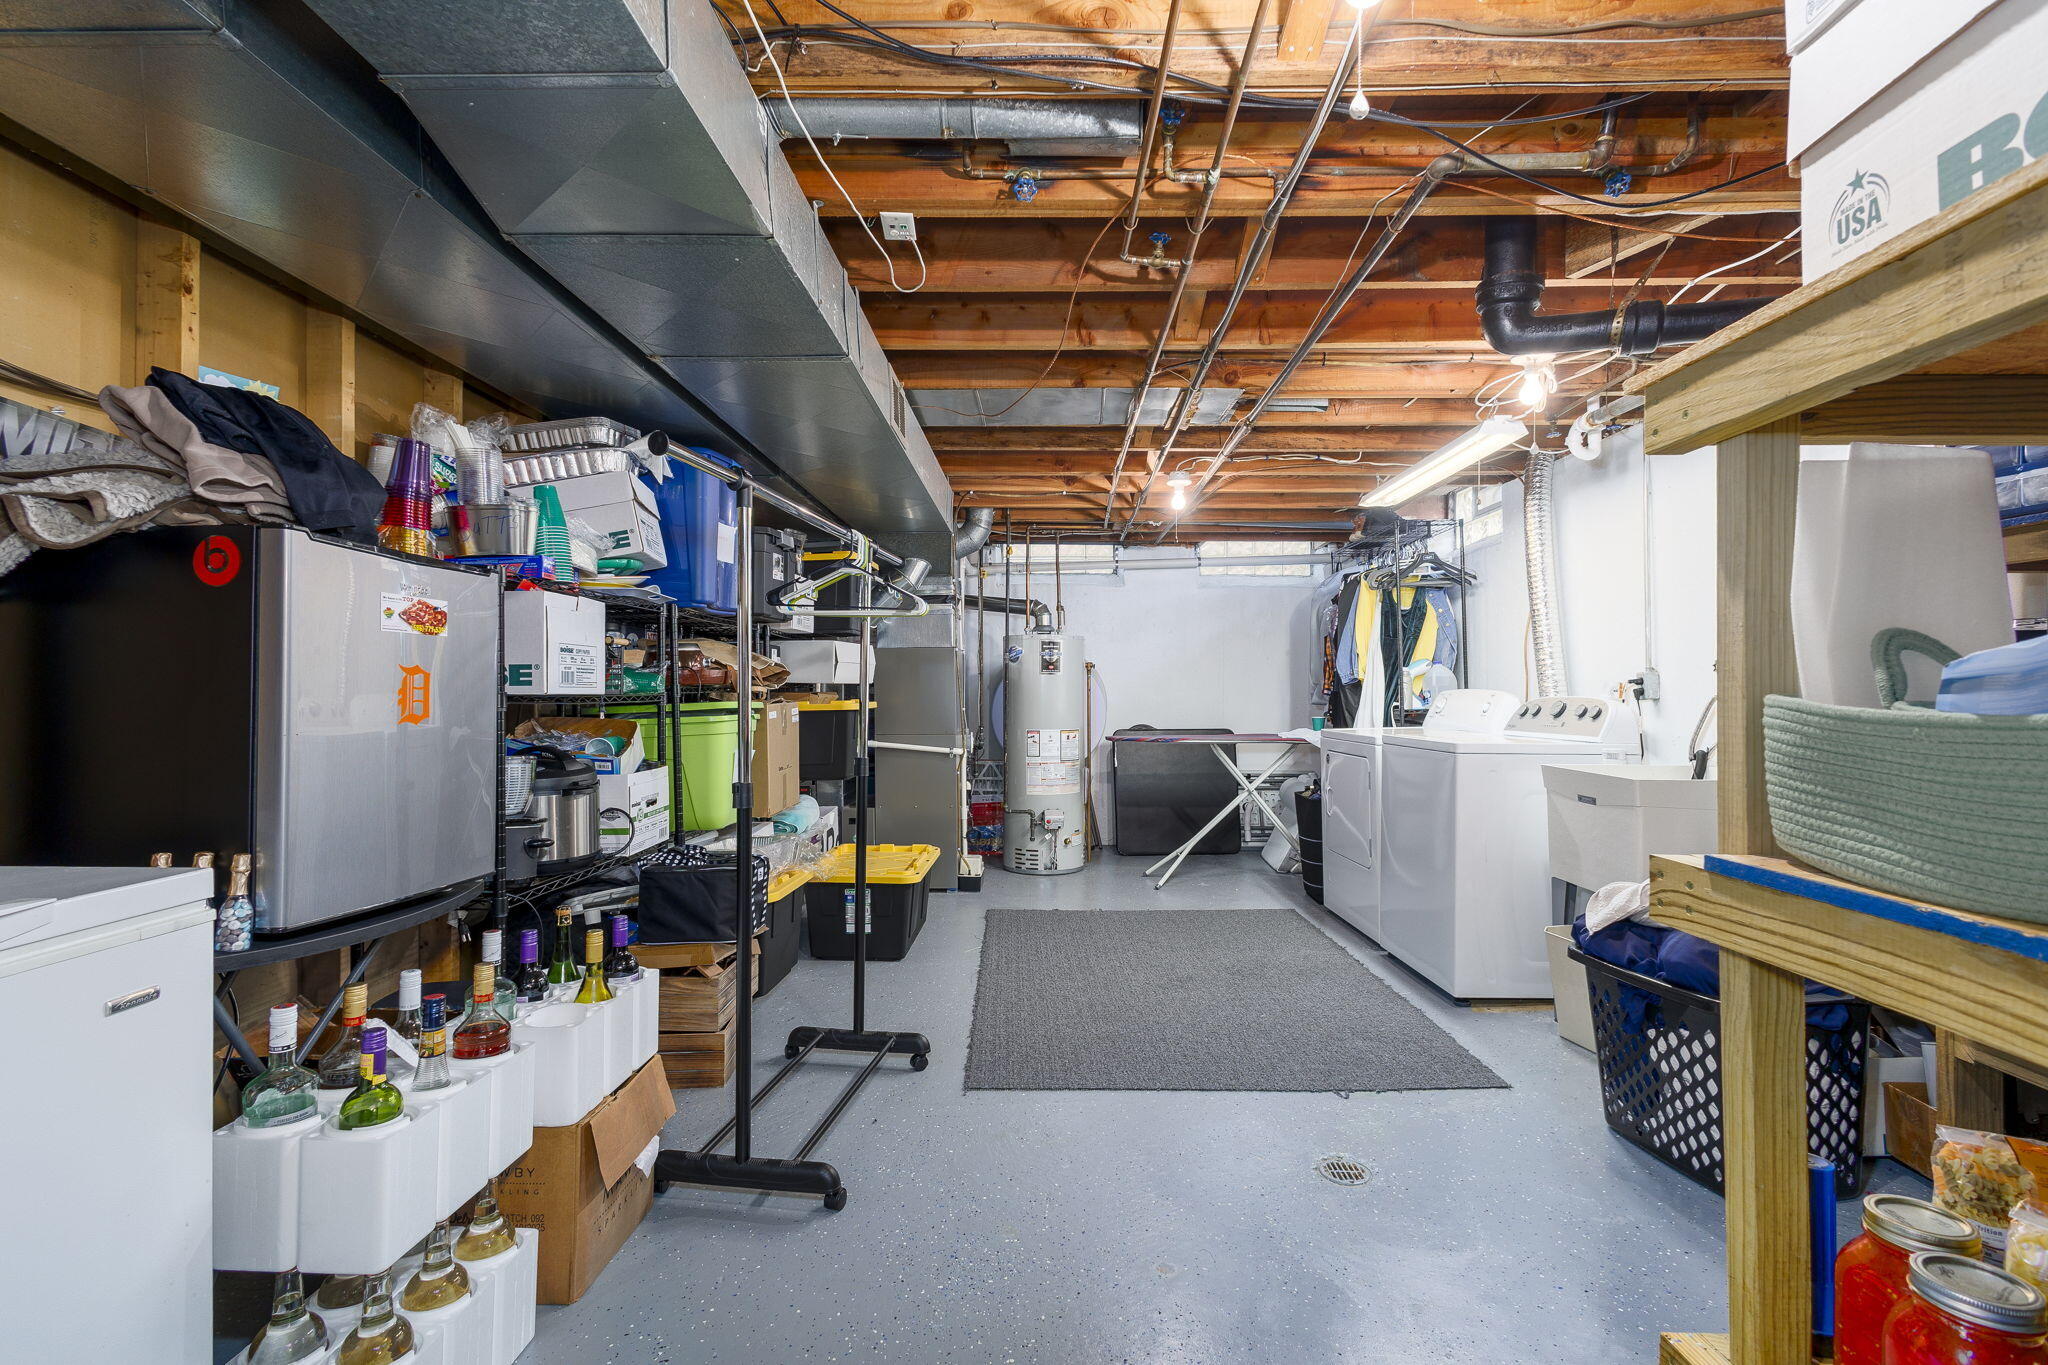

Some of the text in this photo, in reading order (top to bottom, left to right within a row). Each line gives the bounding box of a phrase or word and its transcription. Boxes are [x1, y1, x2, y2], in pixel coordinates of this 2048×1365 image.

[1837, 196, 1882, 245] USA
[397, 664, 430, 725] D
[530, 1214, 545, 1223] 092
